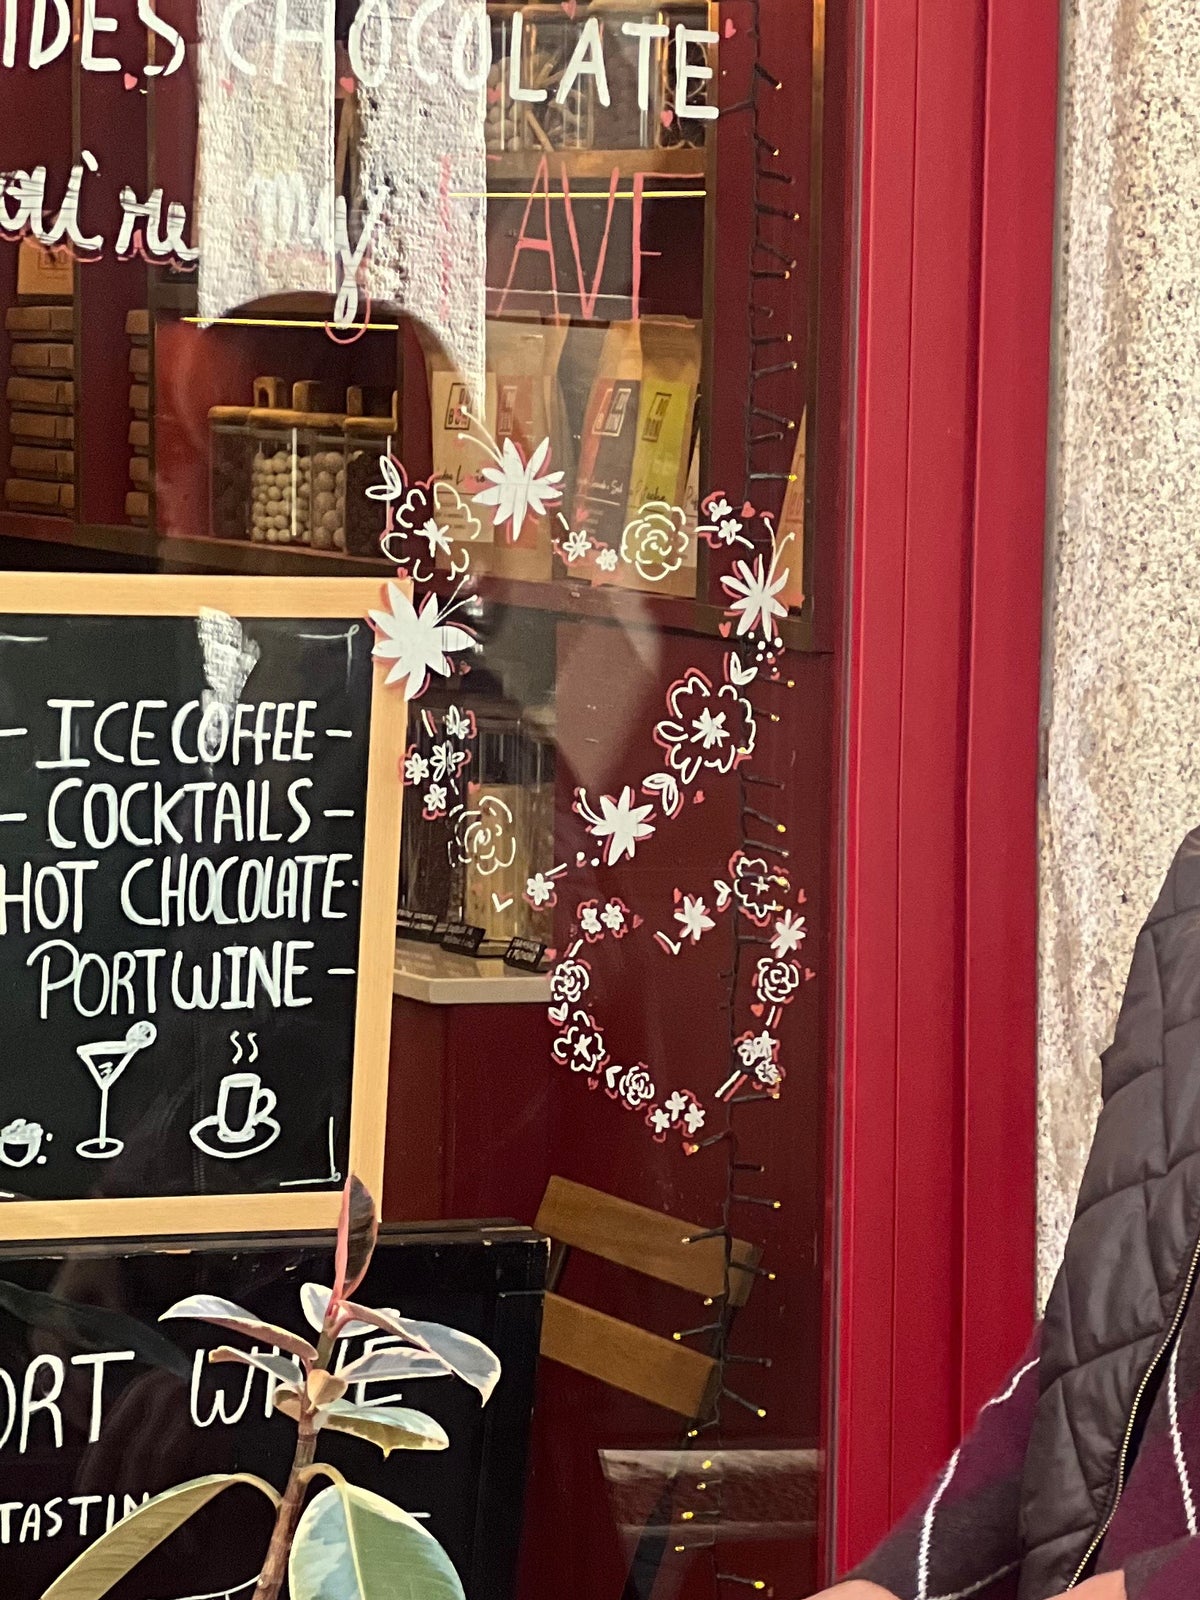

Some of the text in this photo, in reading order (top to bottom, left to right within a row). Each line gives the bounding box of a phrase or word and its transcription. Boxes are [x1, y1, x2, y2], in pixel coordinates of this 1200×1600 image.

[219, 0, 720, 119] CHOCOLATE
[35, 699, 318, 770] ICE COFFEE
[47, 778, 314, 849] COCKTAILS
[0, 853, 354, 935] HOT CHOCOLATE
[26, 939, 315, 1019] PORT WINE
[0, 1491, 150, 1544] TASTIN
